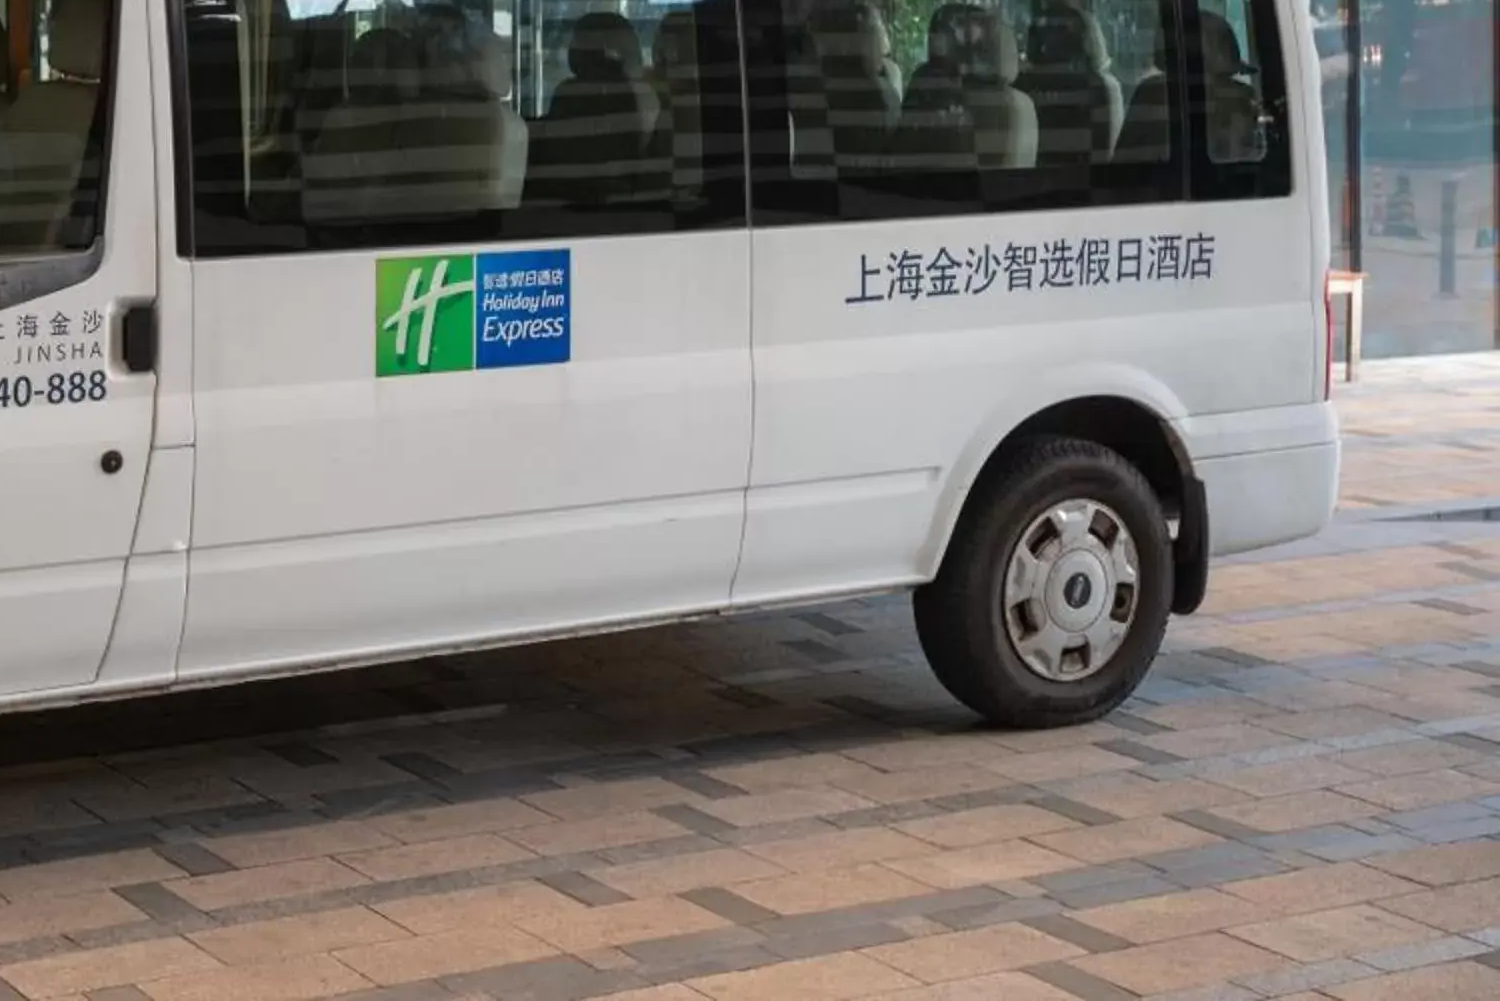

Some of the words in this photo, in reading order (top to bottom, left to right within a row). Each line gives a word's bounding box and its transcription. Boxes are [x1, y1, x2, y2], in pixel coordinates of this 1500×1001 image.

[845, 232, 1215, 304] 上海金沙智选假日酒店
[483, 290, 540, 314] Holiday
[541, 288, 565, 308] Inn
[483, 315, 565, 347] Express
[13, 340, 104, 366] JINSHA
